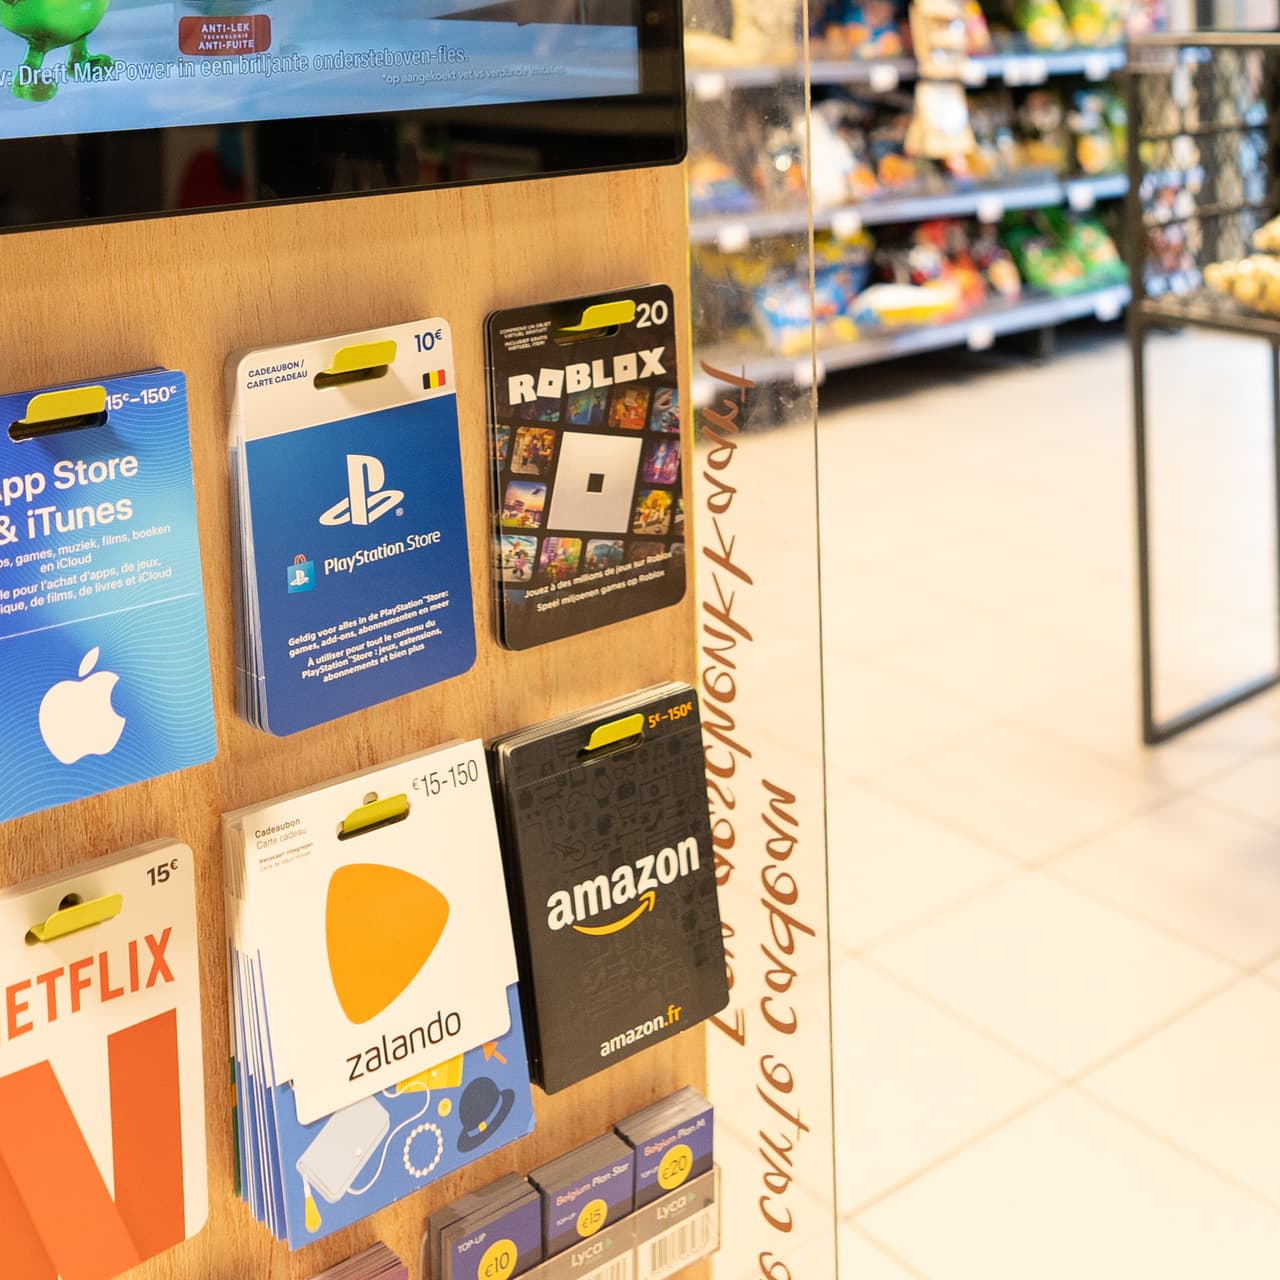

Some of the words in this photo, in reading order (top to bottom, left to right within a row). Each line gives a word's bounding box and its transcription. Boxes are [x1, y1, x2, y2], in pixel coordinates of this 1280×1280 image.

[198, 39, 255, 50] ANTI-FUITE
[201, 23, 250, 33] ANTI-LEK
[19, 64, 69, 87] Dreft
[72, 58, 173, 83] MaxPower
[178, 56, 196, 78] in
[201, 57, 236, 77] een
[238, 52, 310, 79] briljante
[312, 45, 470, 72] ondersteboven-fles.
[635, 299, 669, 329] 20
[414, 328, 442, 353] 10€
[246, 376, 274, 390] CARTE
[274, 369, 308, 385] CADEAU
[248, 360, 300, 378] CADEAUBON
[508, 346, 667, 406] ROBLOX
[52, 454, 140, 491] Store
[26, 497, 134, 540] iTunes
[15, 548, 57, 568] games,
[57, 538, 100, 557] muziek,
[101, 531, 131, 548] films,
[132, 523, 172, 541] boeken
[39, 562, 54, 574] en
[56, 552, 93, 571] iCloud
[323, 540, 406, 576] PlayStation
[406, 530, 442, 552] Store
[11, 582, 39, 600] pour
[120, 561, 136, 574] de
[30, 594, 46, 609] de
[78, 583, 94, 598] de
[124, 573, 137, 587] et
[138, 567, 173, 584] iCloud
[288, 642, 320, 659] games,
[320, 630, 357, 648] add-ons,
[358, 610, 418, 636] abonnementen
[418, 605, 429, 616] en
[429, 599, 450, 613] meer
[288, 631, 317, 648] Geldig
[317, 624, 338, 638] voor
[338, 619, 358, 632] alles
[358, 616, 367, 625] in
[368, 612, 379, 622] de
[316, 649, 345, 665] utiliser
[346, 642, 366, 657] pour
[366, 636, 383, 648] tout
[384, 632, 393, 642] le
[393, 623, 425, 640] contenu
[425, 618, 437, 629] du
[378, 642, 399, 657] jeux,
[399, 627, 443, 648] extensions,
[323, 658, 380, 683] abonnements
[380, 653, 389, 664] et
[389, 648, 408, 661] bien
[408, 642, 426, 657] plus
[411, 758, 479, 798] €15-150
[254, 818, 301, 839] Cadeaubon
[145, 857, 179, 887] 15€
[546, 835, 701, 932] amazon
[346, 1010, 462, 1082] zalando
[599, 1004, 683, 1058] amazon.fr
[555, 1183, 592, 1208] Belgium
[591, 1171, 613, 1188] Plan
[656, 1194, 688, 1221] Lyca
[457, 1231, 488, 1255] TOP-UP
[570, 1242, 605, 1269] Lyca
